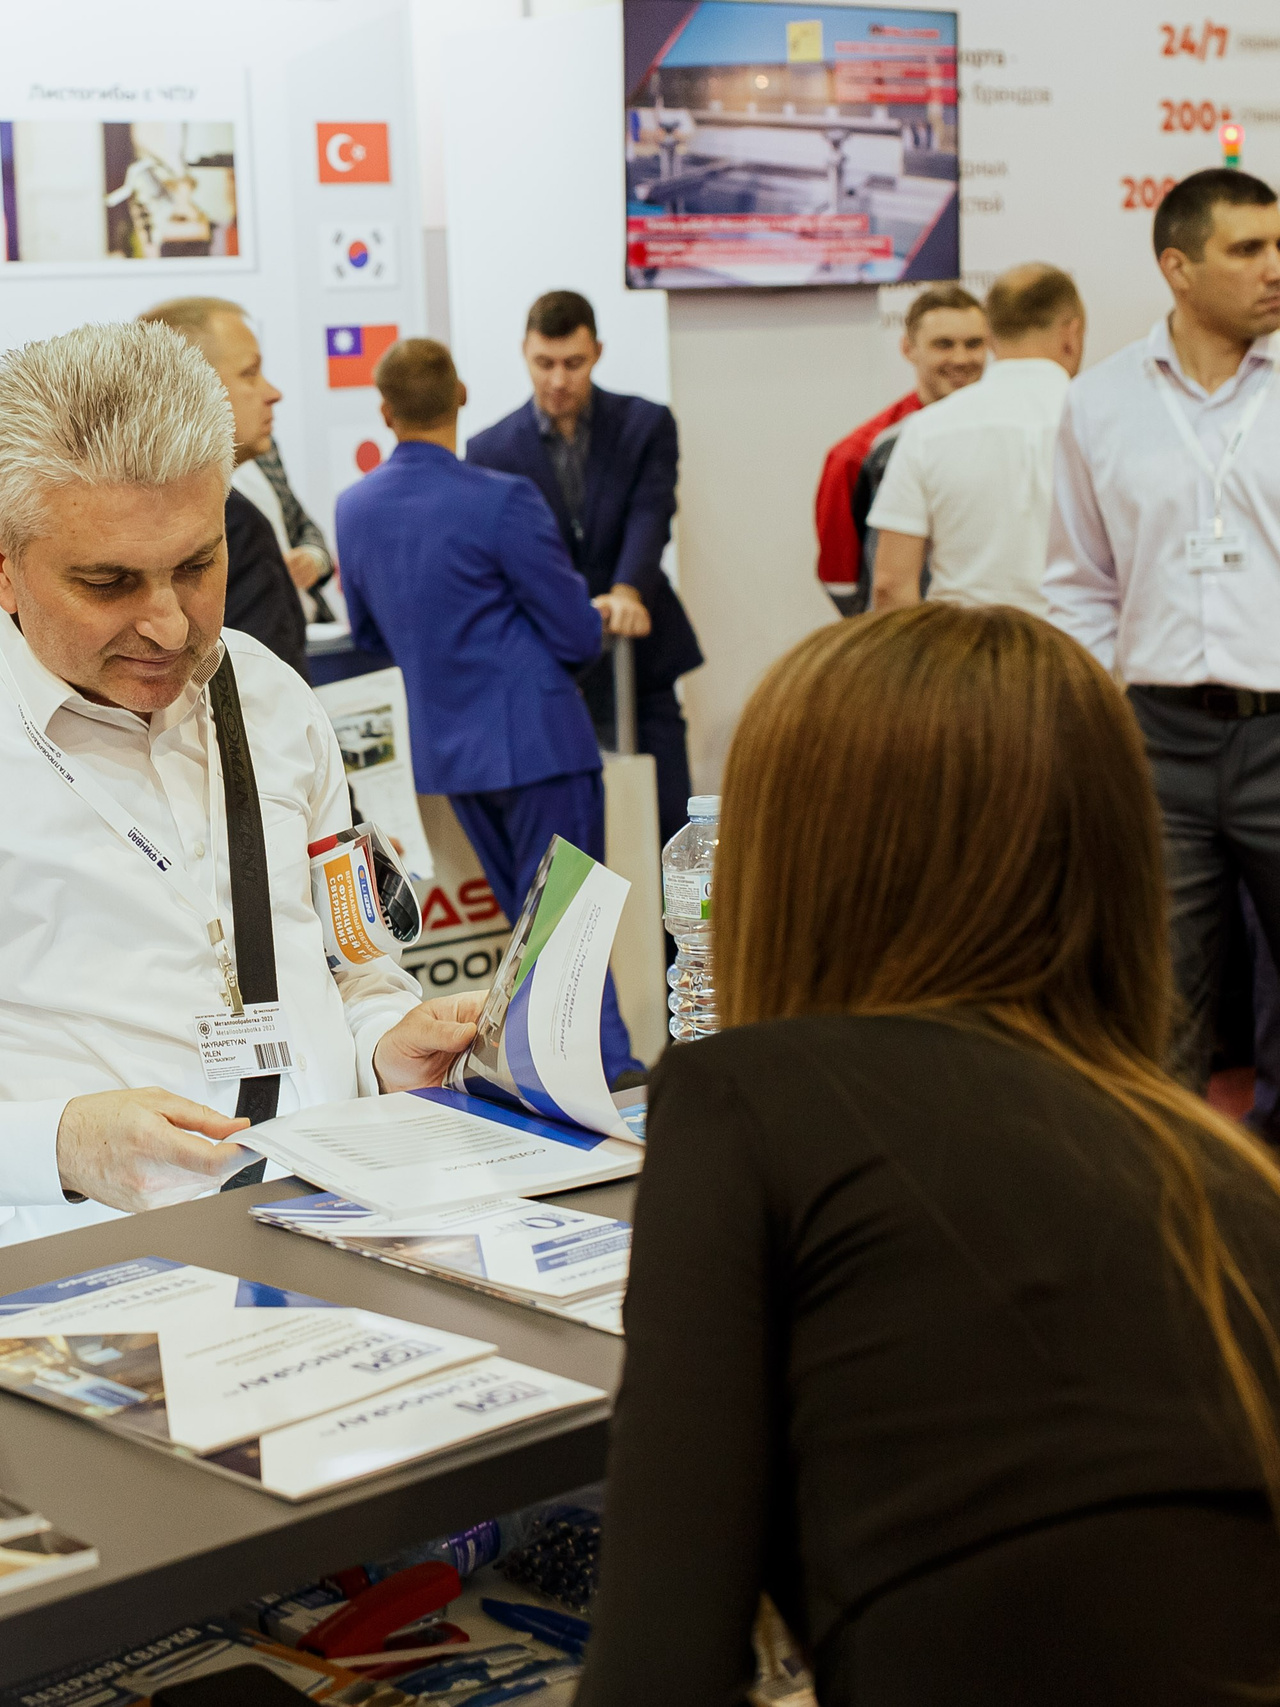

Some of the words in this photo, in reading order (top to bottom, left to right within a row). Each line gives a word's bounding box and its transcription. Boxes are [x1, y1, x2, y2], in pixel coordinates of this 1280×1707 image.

[1159, 18, 1230, 62] 24/7
[28, 83, 137, 104] Листогибы
[158, 84, 198, 103] ЧПУ
[1159, 99, 1233, 133] 200+
[126, 828, 160, 864] ФИНВАЛ
[336, 873, 344, 882] С
[329, 877, 349, 947] СВЕРЛЕНИЯ
[338, 884, 361, 949] ФУНКЦИЕЙ
[345, 870, 361, 930] ВЕРТИКАЛЬНЫЙ
[570, 903, 597, 980] лазерные
[586, 905, 602, 943] ООО
[201, 1039, 247, 1049] HAYRAPETYAN
[123, 1626, 203, 1667] СВАРКИ
